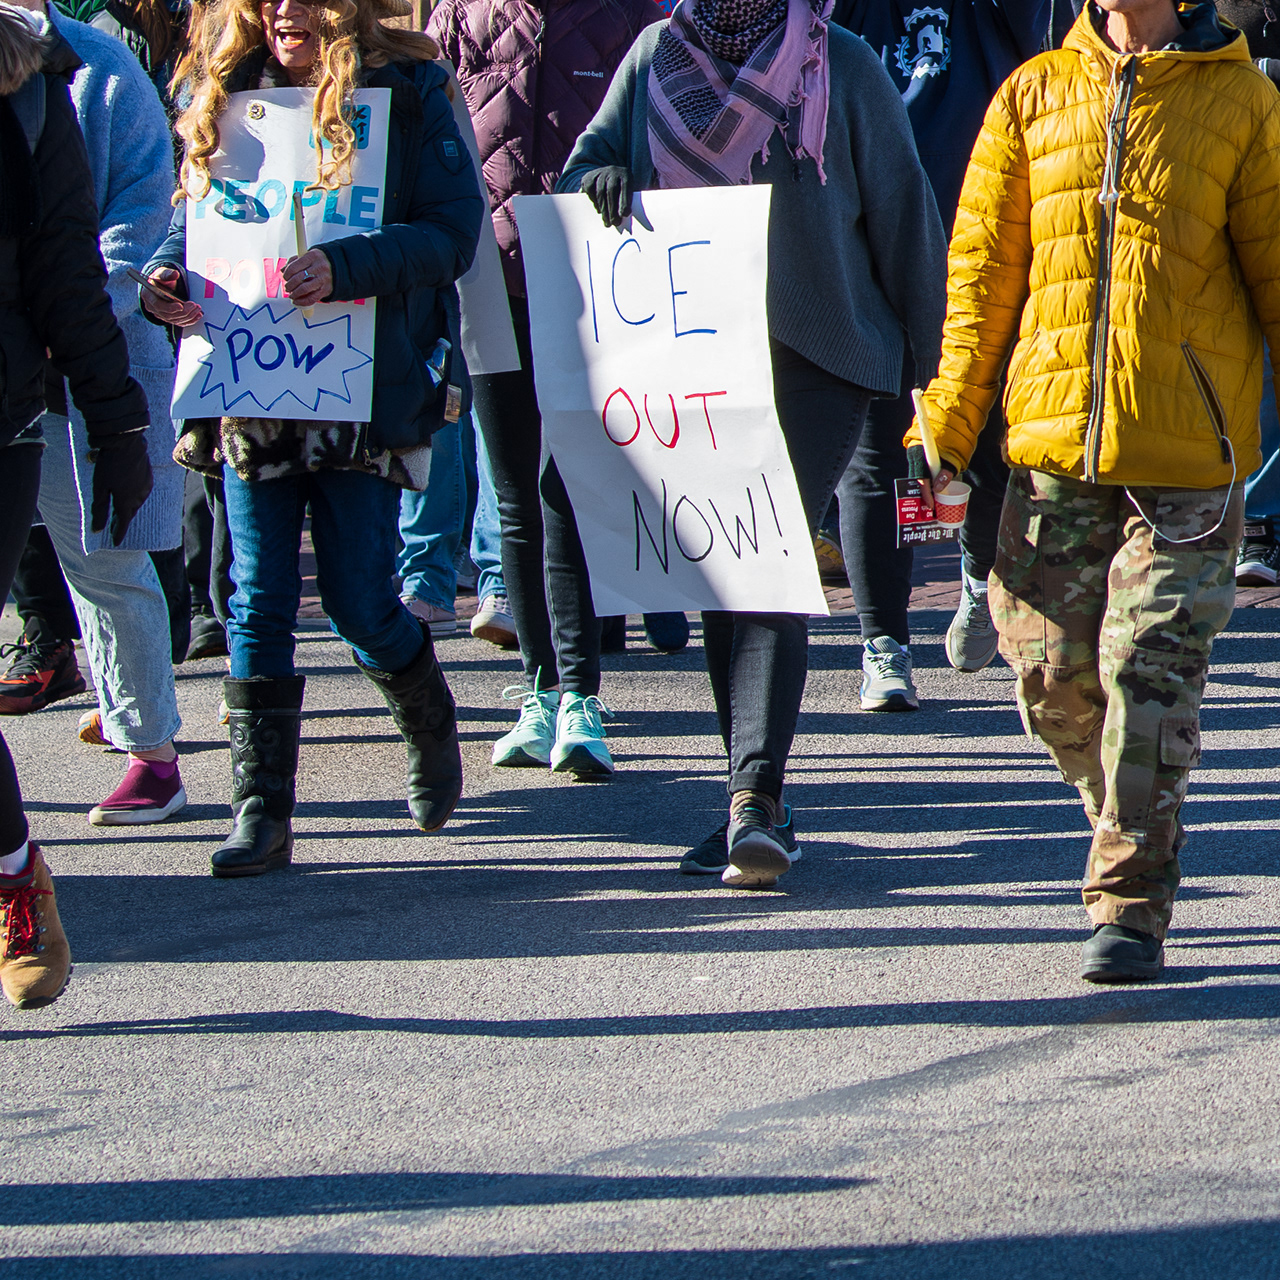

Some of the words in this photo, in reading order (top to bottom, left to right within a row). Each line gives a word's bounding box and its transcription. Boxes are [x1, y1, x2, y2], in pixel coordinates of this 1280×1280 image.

[194, 178, 380, 228] PEOPLE
[204, 257, 366, 307] POW
[586, 238, 718, 344] ICE
[226, 327, 335, 384] POW
[602, 387, 728, 451] OUT
[632, 473, 790, 575] NOW!
[903, 530, 927, 543] People
